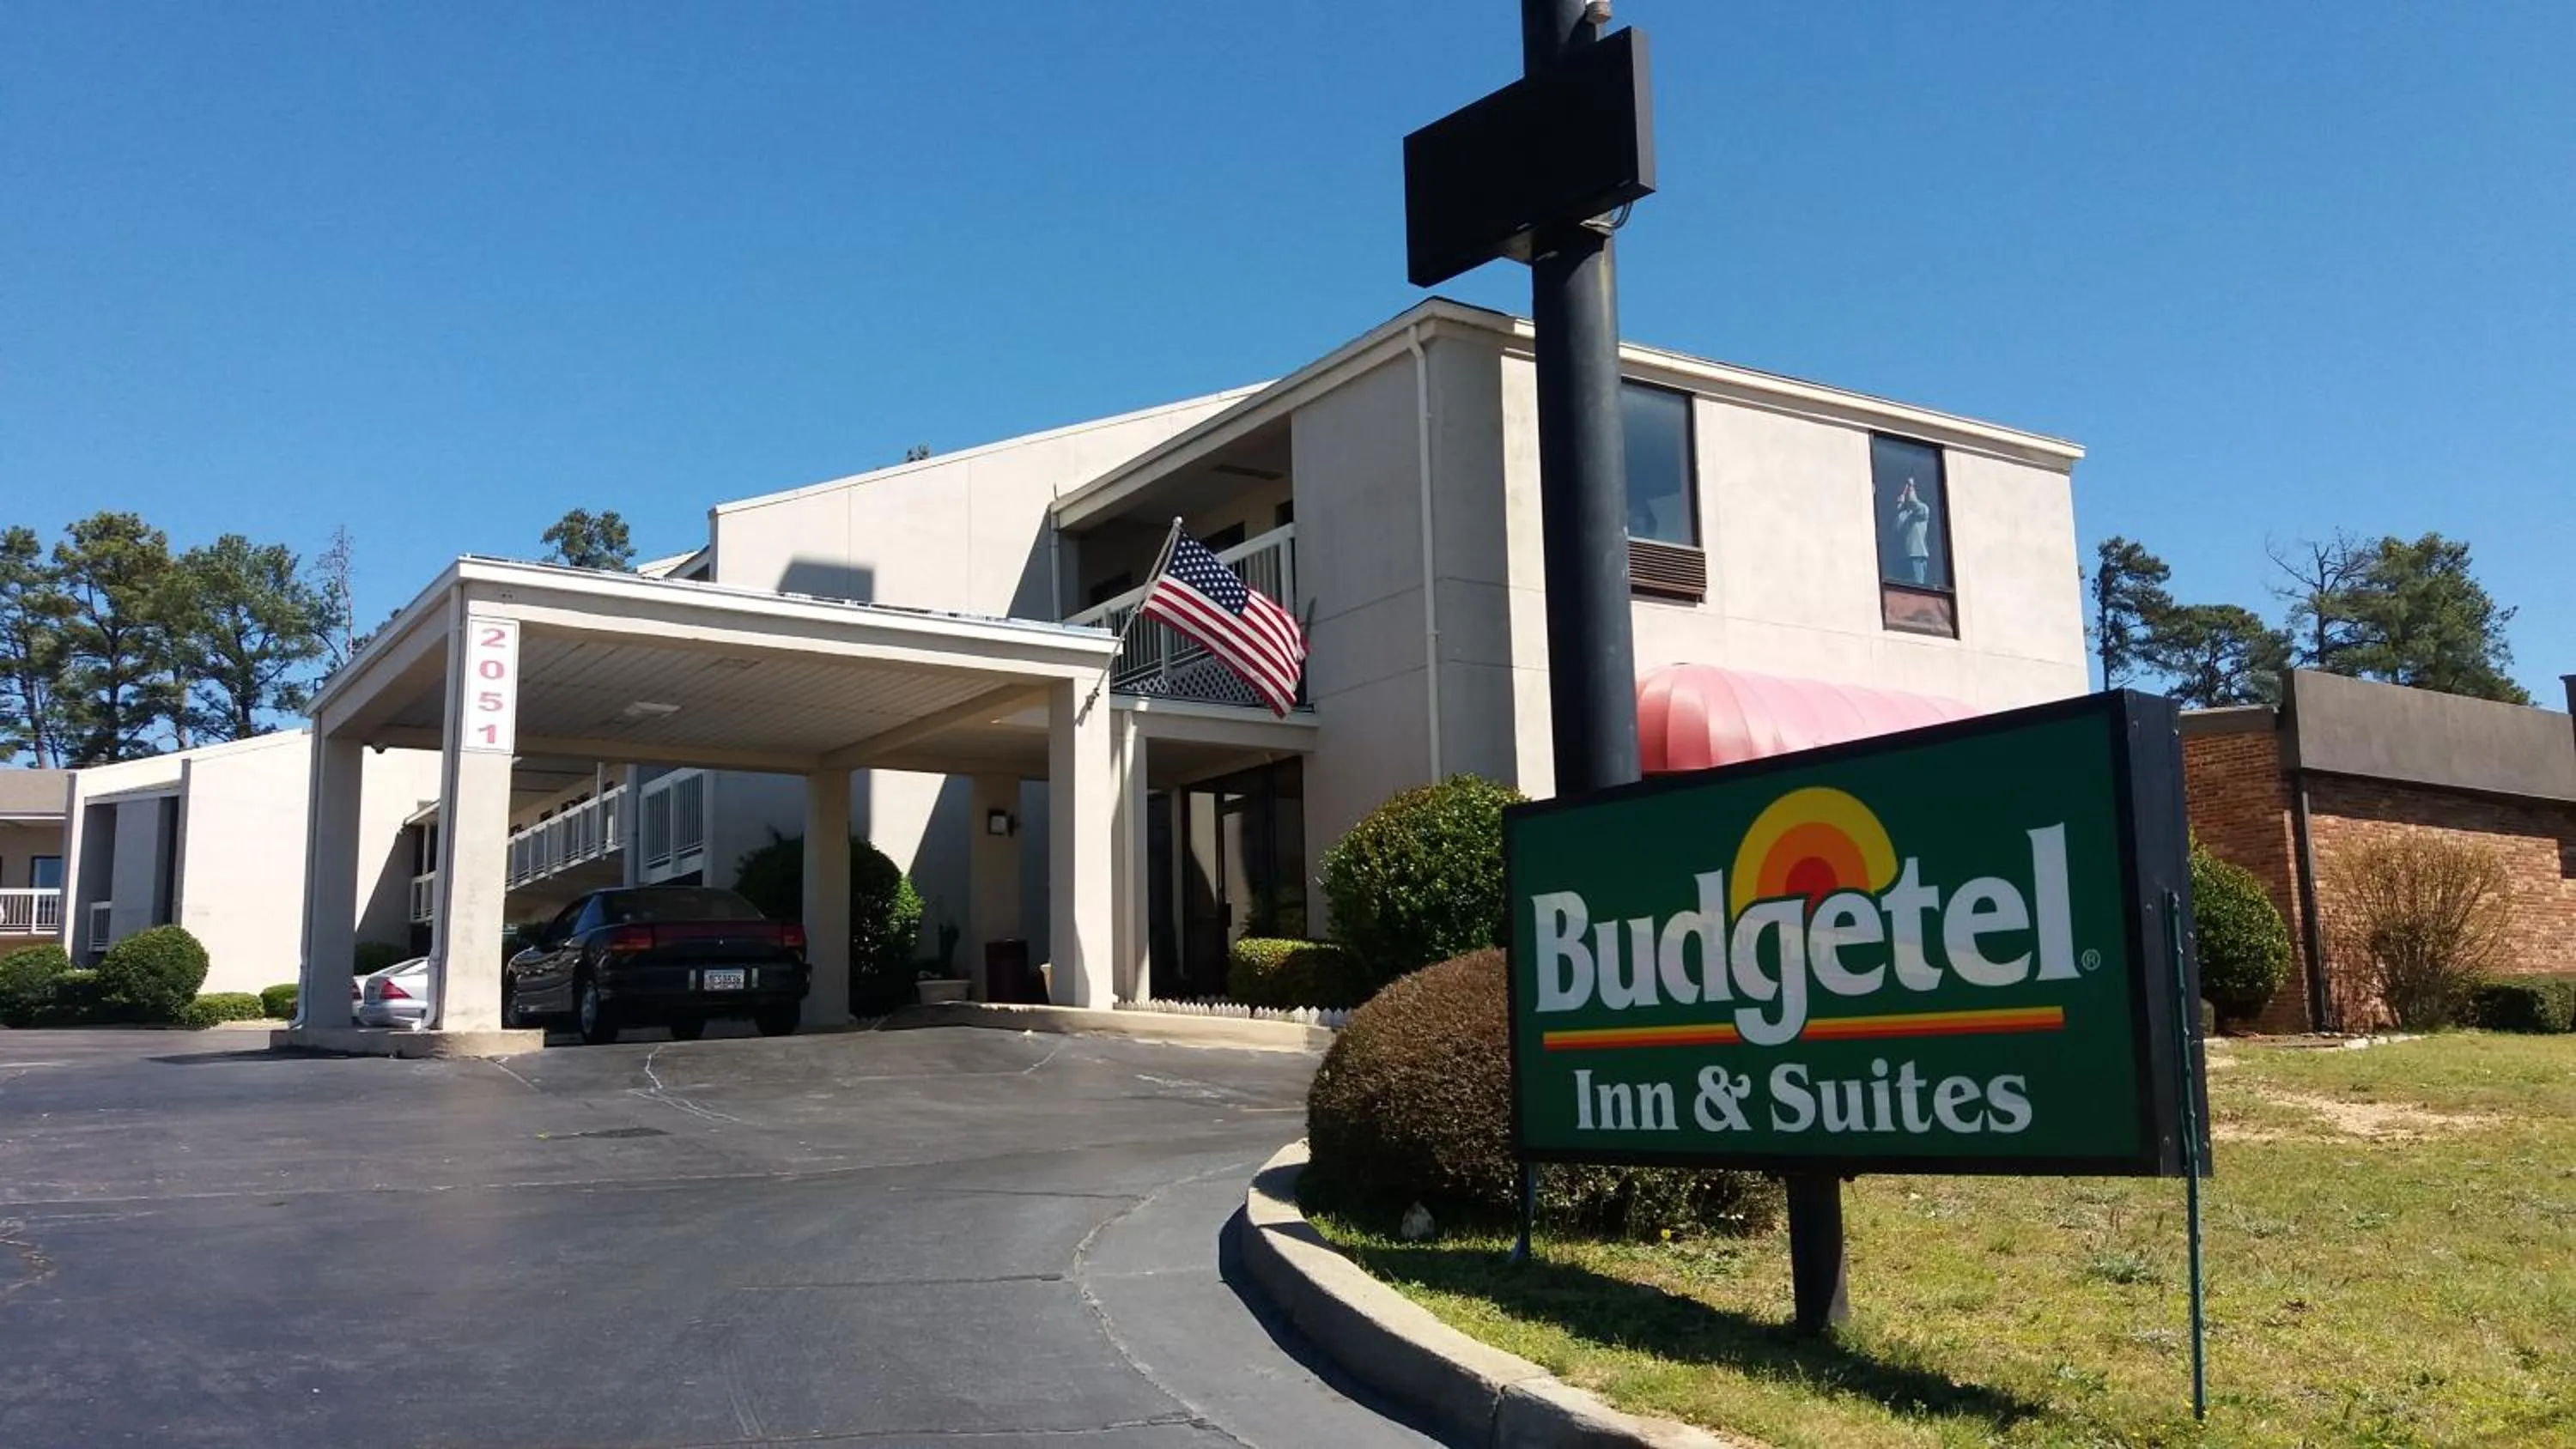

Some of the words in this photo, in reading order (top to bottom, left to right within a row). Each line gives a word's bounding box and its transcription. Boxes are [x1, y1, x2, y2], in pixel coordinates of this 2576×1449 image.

[477, 627, 507, 744] 2051
[1531, 822, 2081, 1046] Budgetel
[1575, 1070, 1679, 1131] Inn
[1693, 1064, 1752, 1132] &
[1770, 1058, 2032, 1134] Suites
